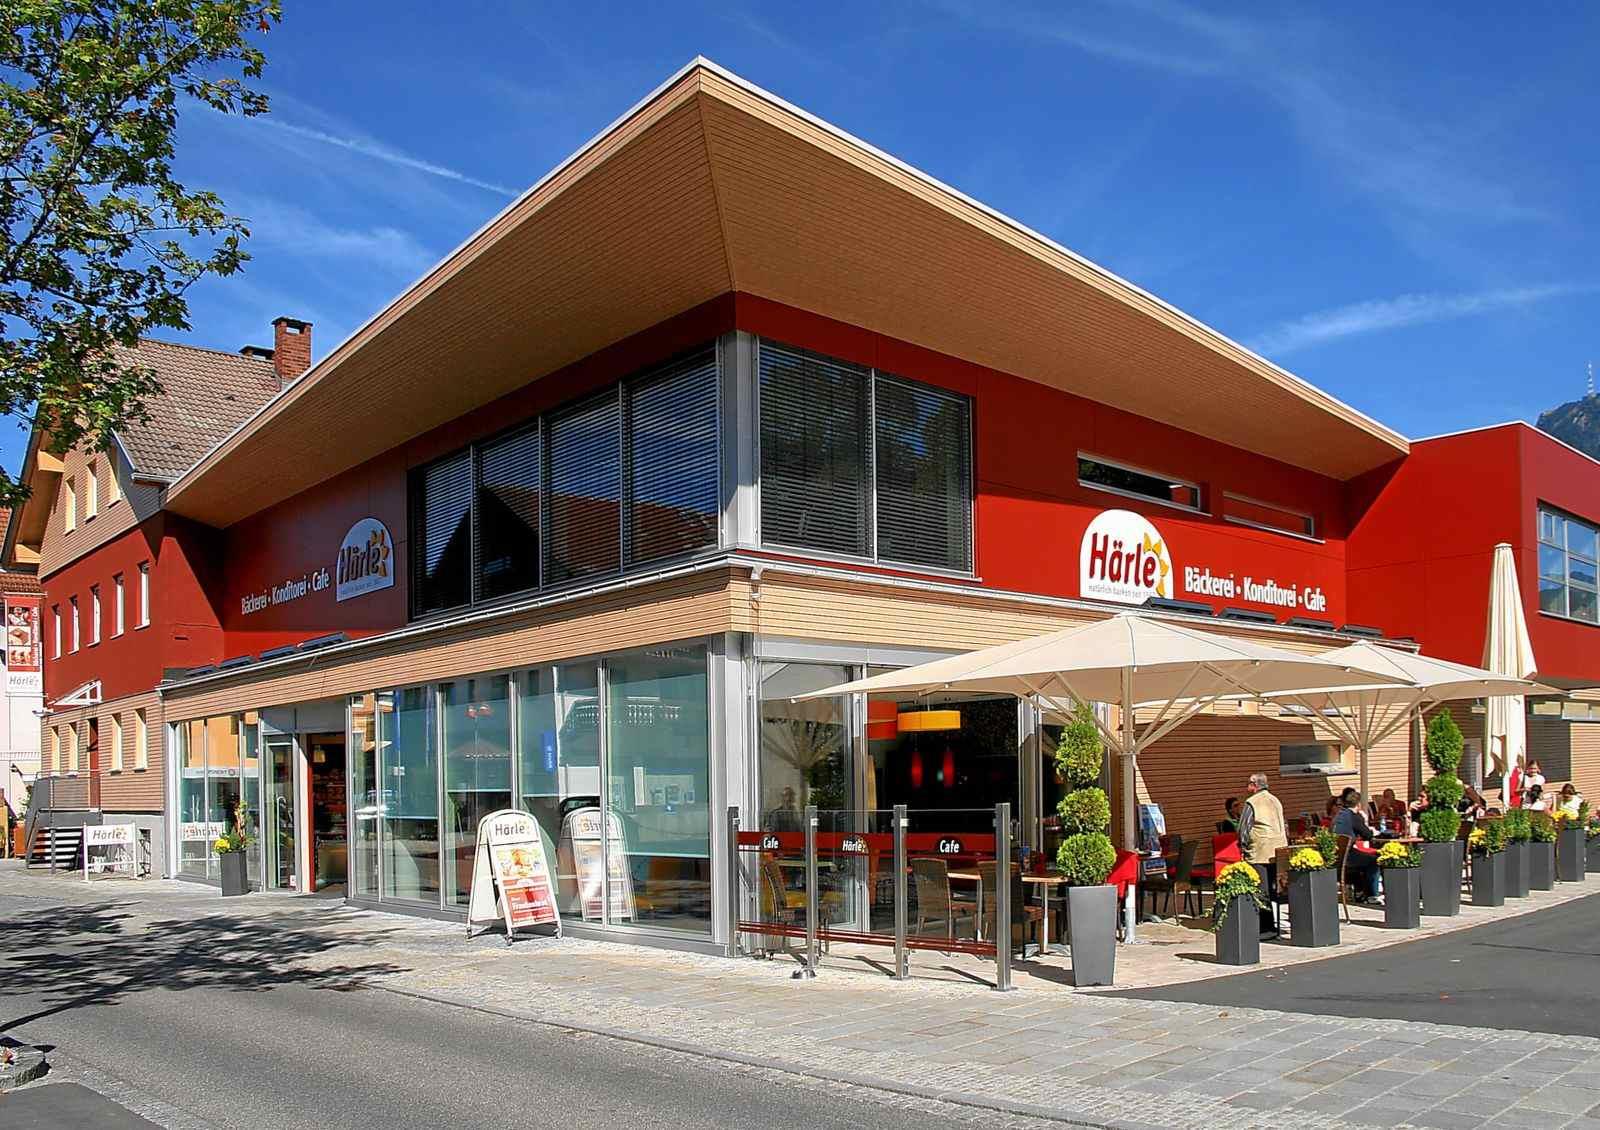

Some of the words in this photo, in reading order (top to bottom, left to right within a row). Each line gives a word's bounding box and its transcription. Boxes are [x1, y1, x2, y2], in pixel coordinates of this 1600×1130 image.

[338, 540, 380, 585] Härle
[1089, 532, 1157, 588] Härle
[241, 589, 268, 616] Bäckerei
[272, 575, 307, 605] Konditorei
[312, 567, 330, 592] Cafe
[1185, 566, 1235, 598] Bäckerei
[1243, 576, 1297, 608] Konditorei
[1304, 587, 1326, 612] Cafe
[494, 823, 525, 836] Härle
[763, 837, 779, 849] Cafe
[842, 839, 862, 852] Härle
[940, 839, 960, 853] Cafe
